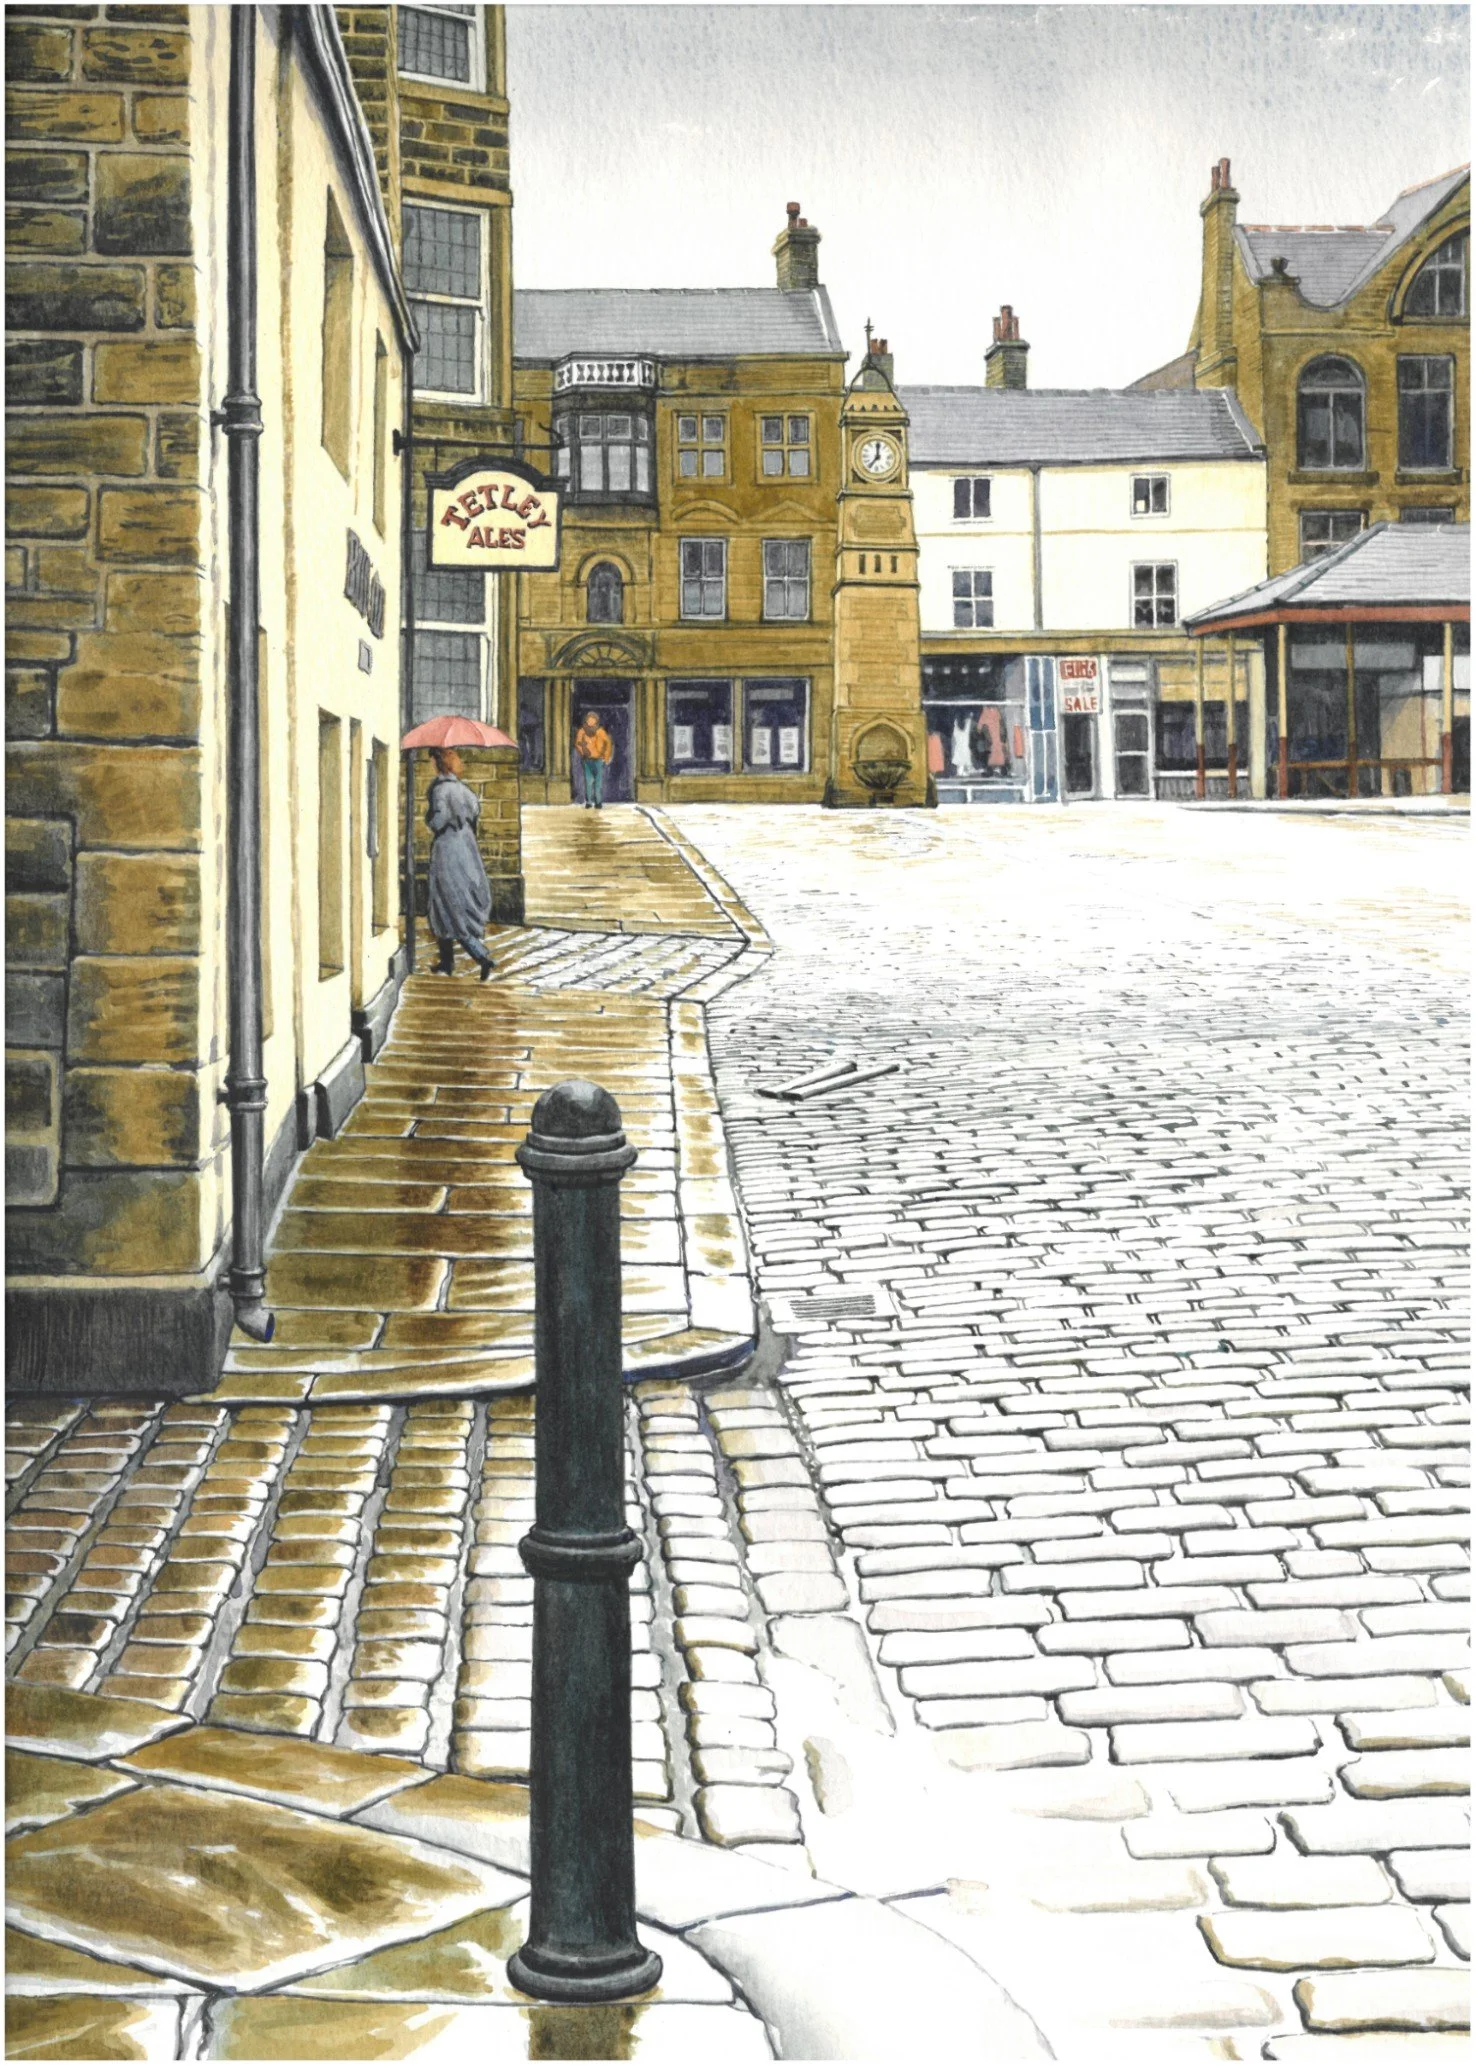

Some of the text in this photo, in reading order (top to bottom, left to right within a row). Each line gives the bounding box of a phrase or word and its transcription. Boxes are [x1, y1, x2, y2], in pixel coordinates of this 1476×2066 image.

[440, 484, 552, 531] TETLEY
[466, 526, 526, 549] ALES
[1064, 696, 1097, 711] SALE
